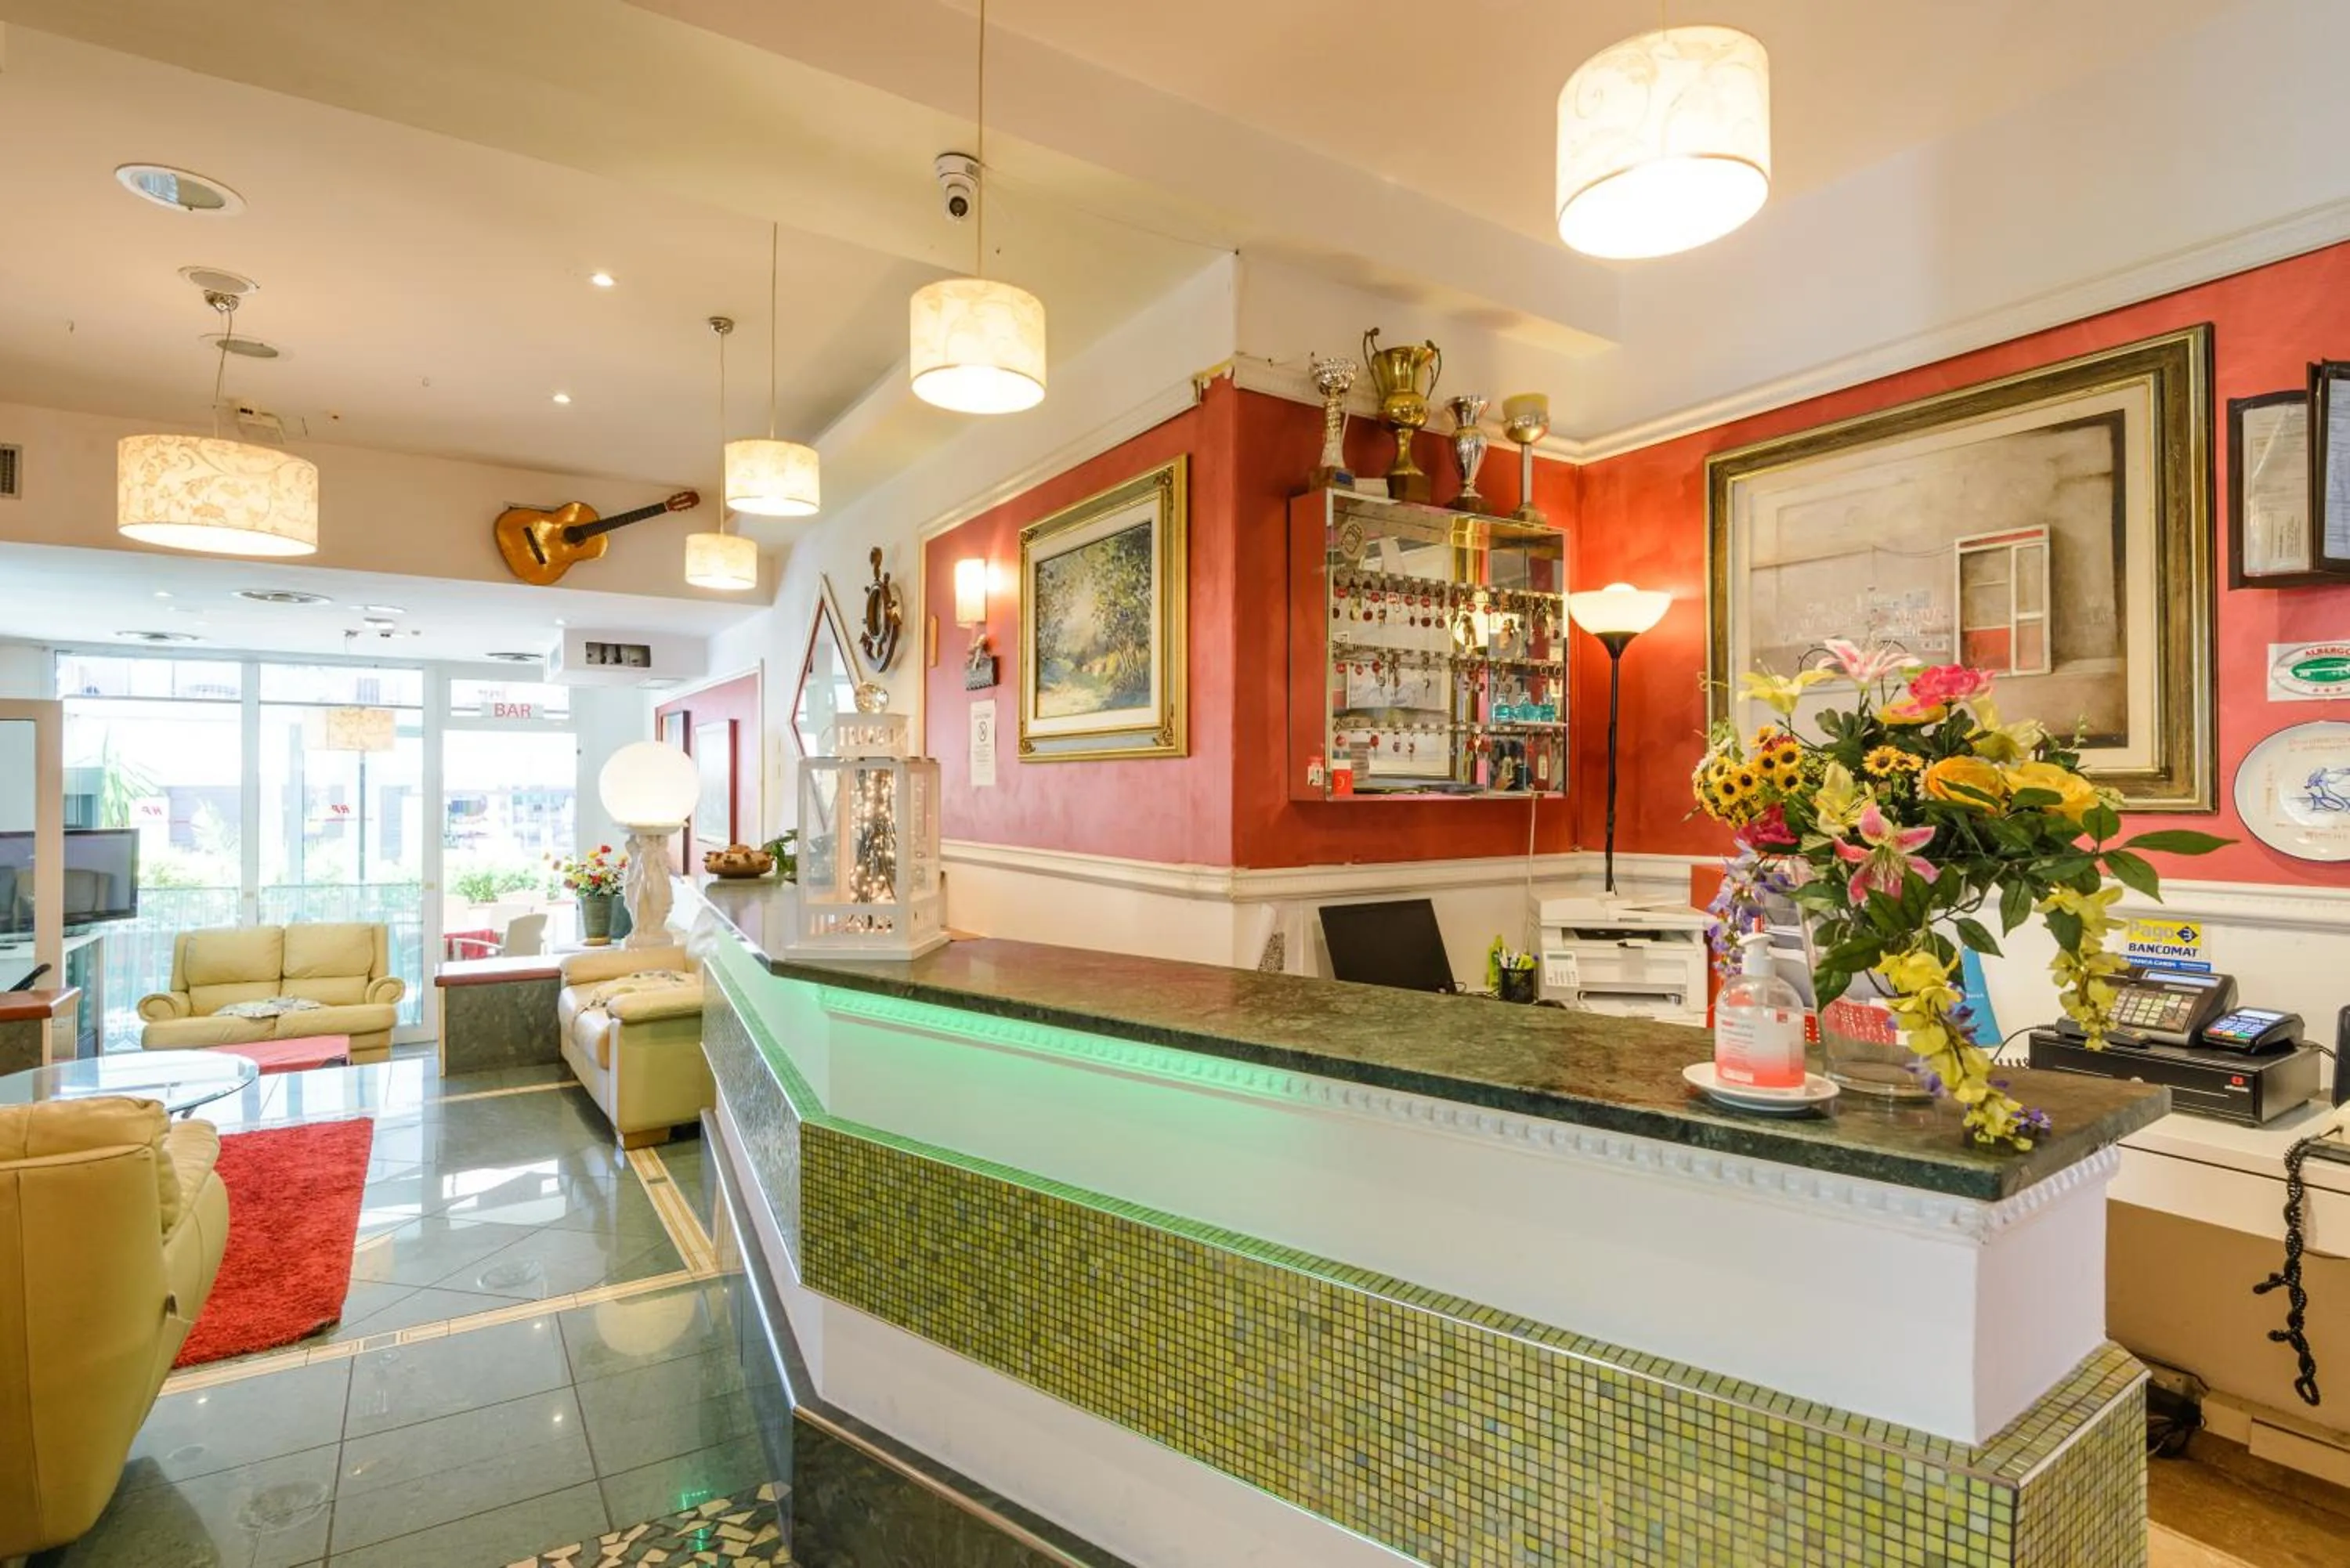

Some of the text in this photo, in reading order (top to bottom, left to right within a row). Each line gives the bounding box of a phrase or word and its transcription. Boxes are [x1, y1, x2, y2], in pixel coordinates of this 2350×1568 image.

[494, 703, 531, 718] BAR
[2128, 920, 2175, 941] Pago
[2128, 942, 2198, 956] BANCOMAT
